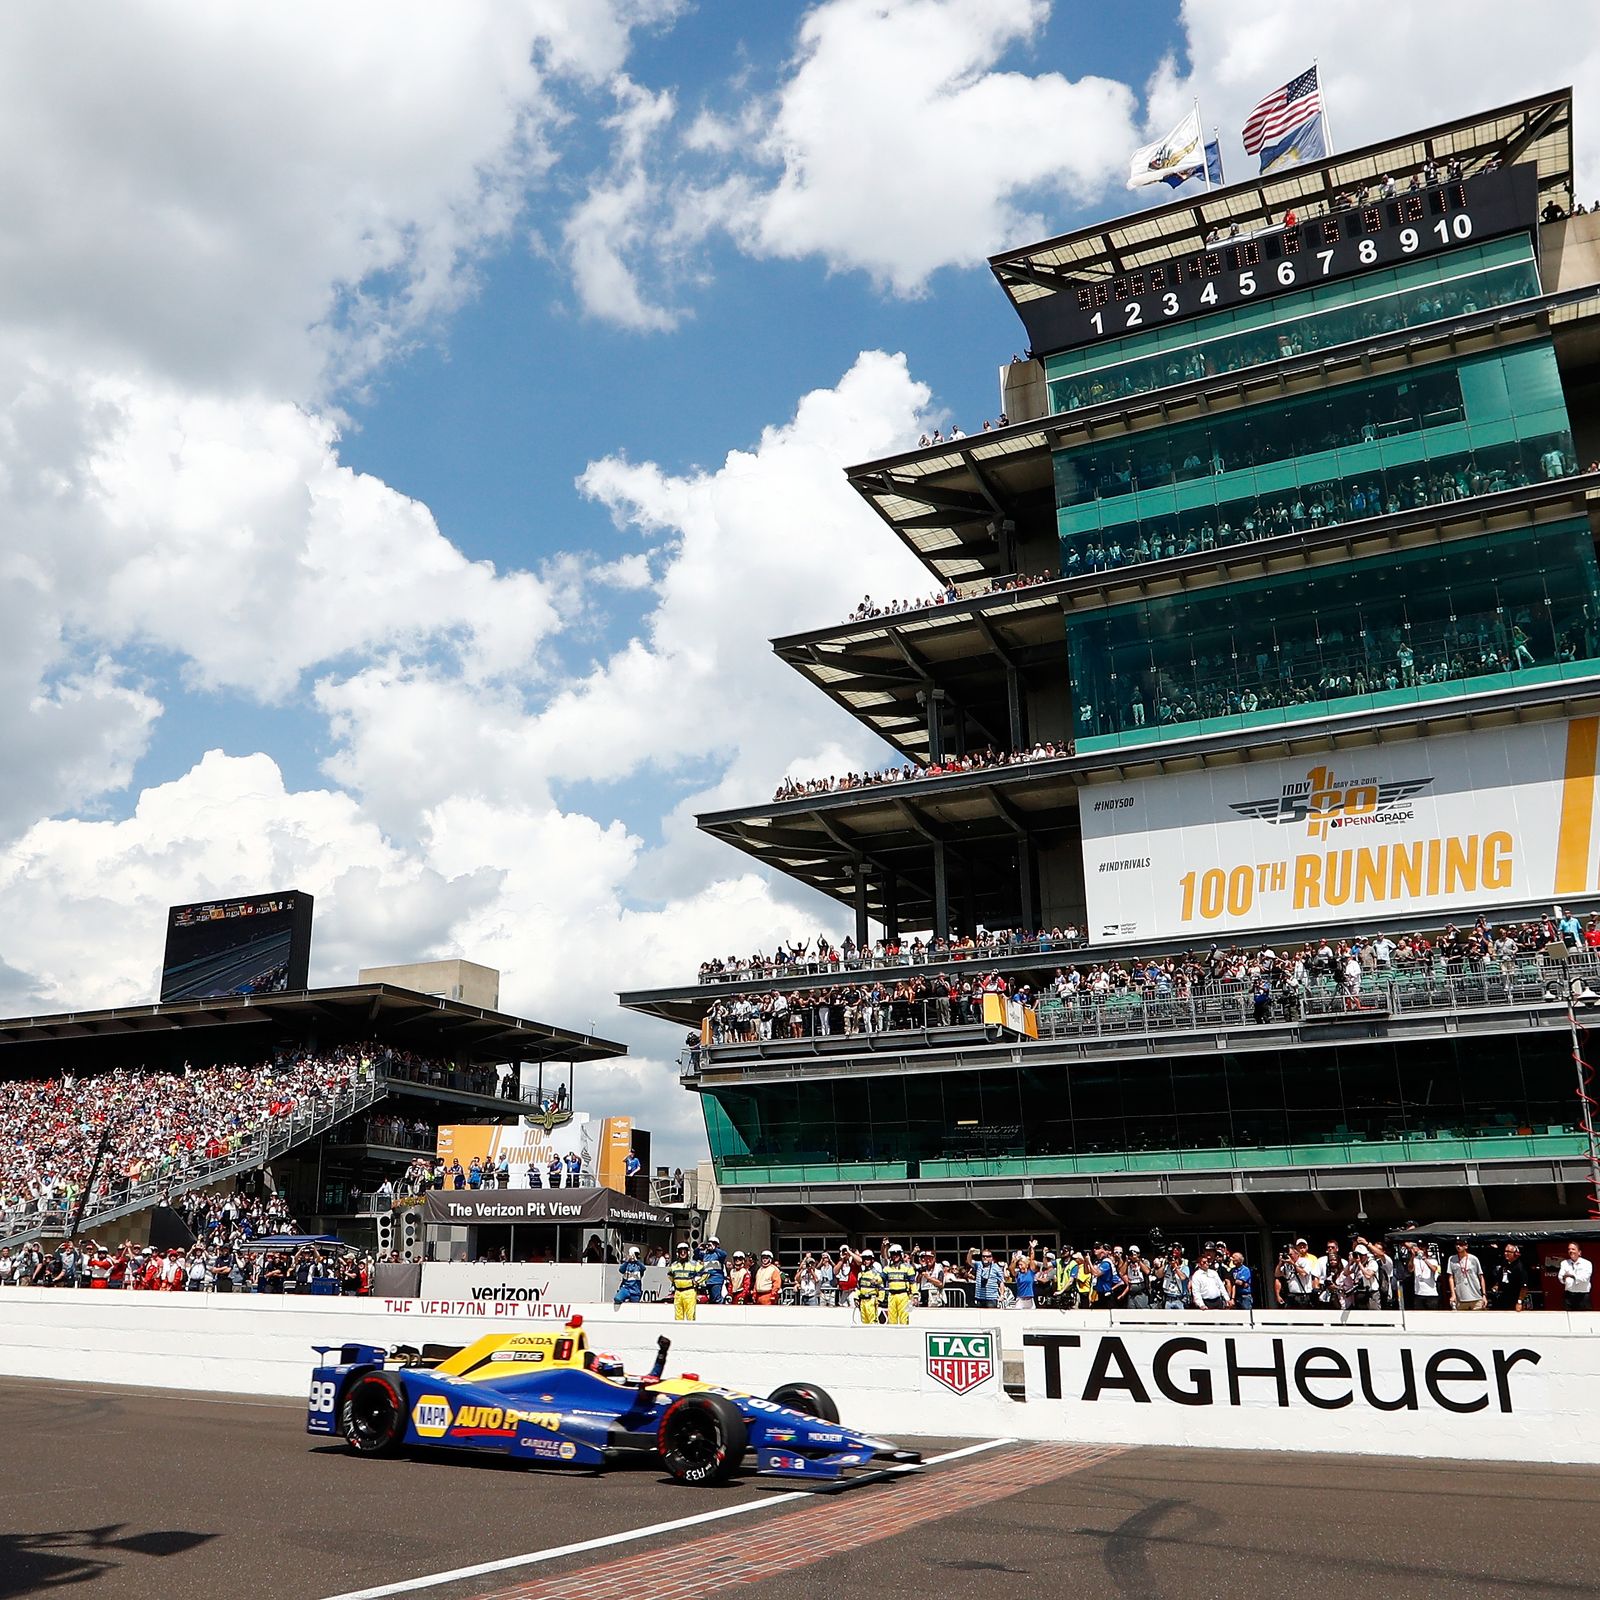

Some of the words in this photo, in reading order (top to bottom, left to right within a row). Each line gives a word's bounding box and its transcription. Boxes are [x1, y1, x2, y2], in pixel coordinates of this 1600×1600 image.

[1077, 283, 1108, 311] 98
[1113, 273, 1145, 301] 26
[1150, 262, 1183, 291] 21
[1188, 252, 1221, 279] 42
[1235, 241, 1260, 268] 10
[1283, 231, 1300, 255] 6
[1323, 219, 1340, 244] 5
[1364, 207, 1382, 233] 9
[1397, 196, 1423, 224] 12
[1439, 184, 1467, 213] 11
[1090, 312, 1104, 335] 1
[1124, 302, 1143, 327] 2
[1162, 292, 1180, 316] 3
[1200, 282, 1218, 305] 4
[1238, 271, 1257, 296] 5
[1277, 261, 1296, 285] 6
[1316, 249, 1335, 275] 7
[1358, 239, 1378, 264] 8
[1399, 228, 1420, 253] 9
[1433, 213, 1473, 244] 10
[1282, 781, 1311, 797] INDY
[1361, 777, 1378, 785] 2016
[1093, 797, 1135, 812] #INDY500
[1278, 785, 1378, 824] 500
[1098, 857, 1151, 873] #INDYRIVALS
[1179, 860, 1287, 921] 100TH
[1293, 830, 1514, 910] RUNNING
[523, 1129, 549, 1146] 100
[448, 1203, 473, 1217] The
[475, 1203, 525, 1217] Verizon
[529, 1203, 547, 1216] Pit
[549, 1202, 582, 1216] View
[620, 1208, 638, 1220] Verizon
[646, 1211, 657, 1222] View
[471, 1283, 541, 1301] verizon
[384, 1300, 411, 1313] THE
[420, 1301, 486, 1316] VERIZON
[495, 1303, 519, 1317] PIT
[527, 1304, 572, 1319] VIEW
[509, 1337, 553, 1345] HONDA
[931, 1335, 987, 1358] TAG
[929, 1359, 991, 1387] HEUER
[309, 1381, 336, 1413] 98
[418, 1406, 446, 1426] NAPA
[454, 1405, 503, 1429] AUTO
